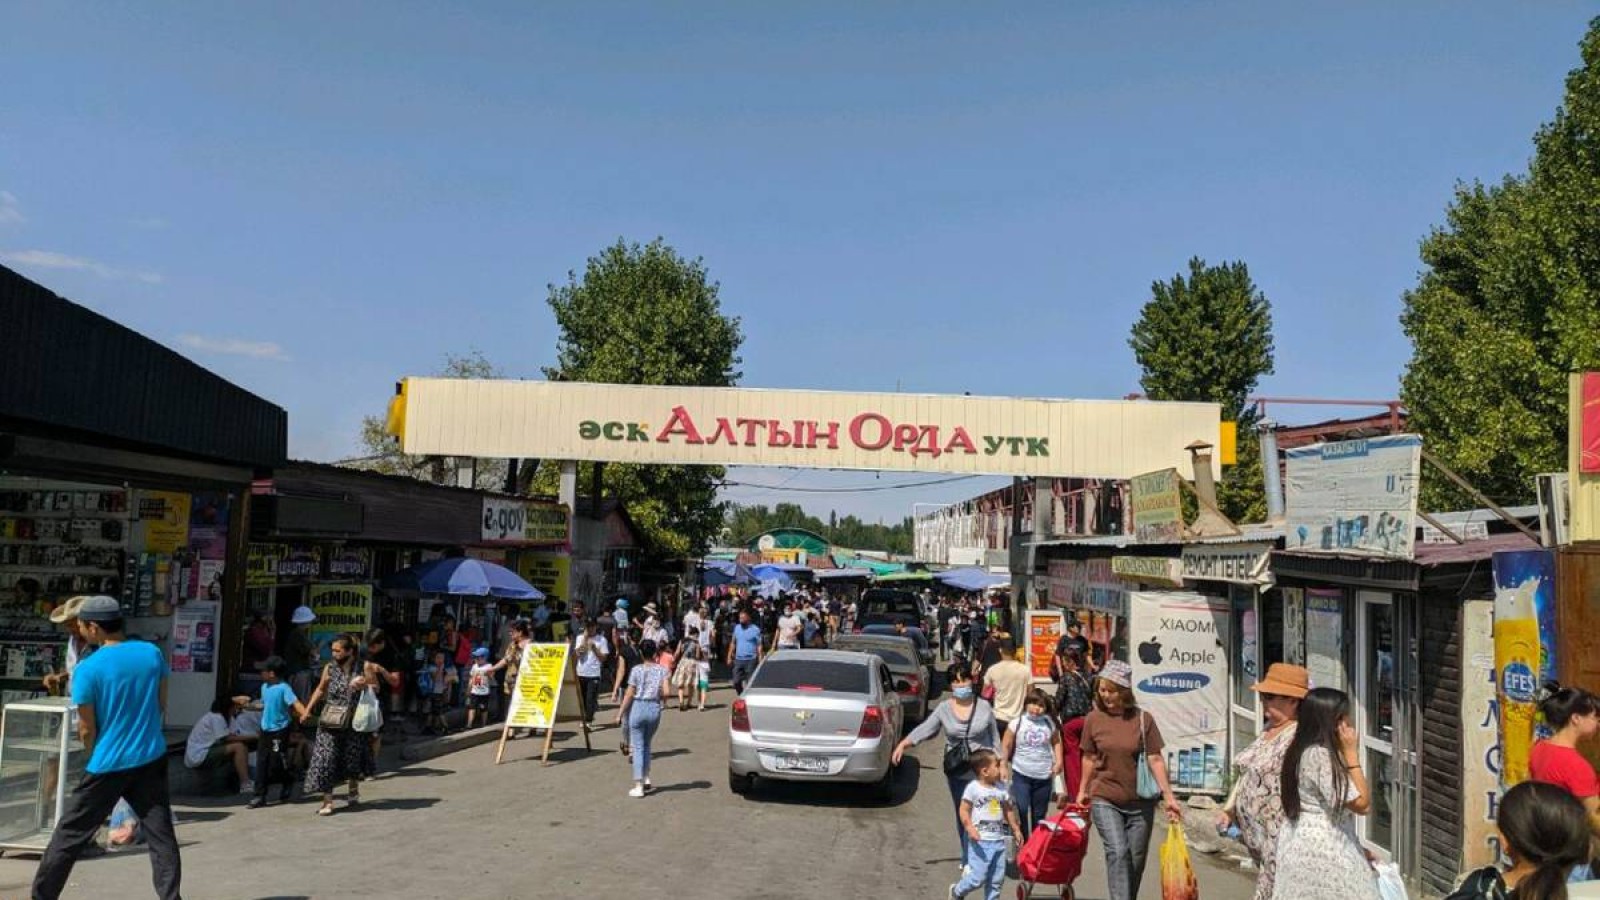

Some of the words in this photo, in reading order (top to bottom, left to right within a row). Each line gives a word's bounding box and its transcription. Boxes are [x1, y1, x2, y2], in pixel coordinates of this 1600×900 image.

[312, 590, 367, 609] РЕМОНТ
[1160, 617, 1215, 633] XIAOMI
[1169, 647, 1216, 666] Apple
[1503, 671, 1535, 693] EFES
